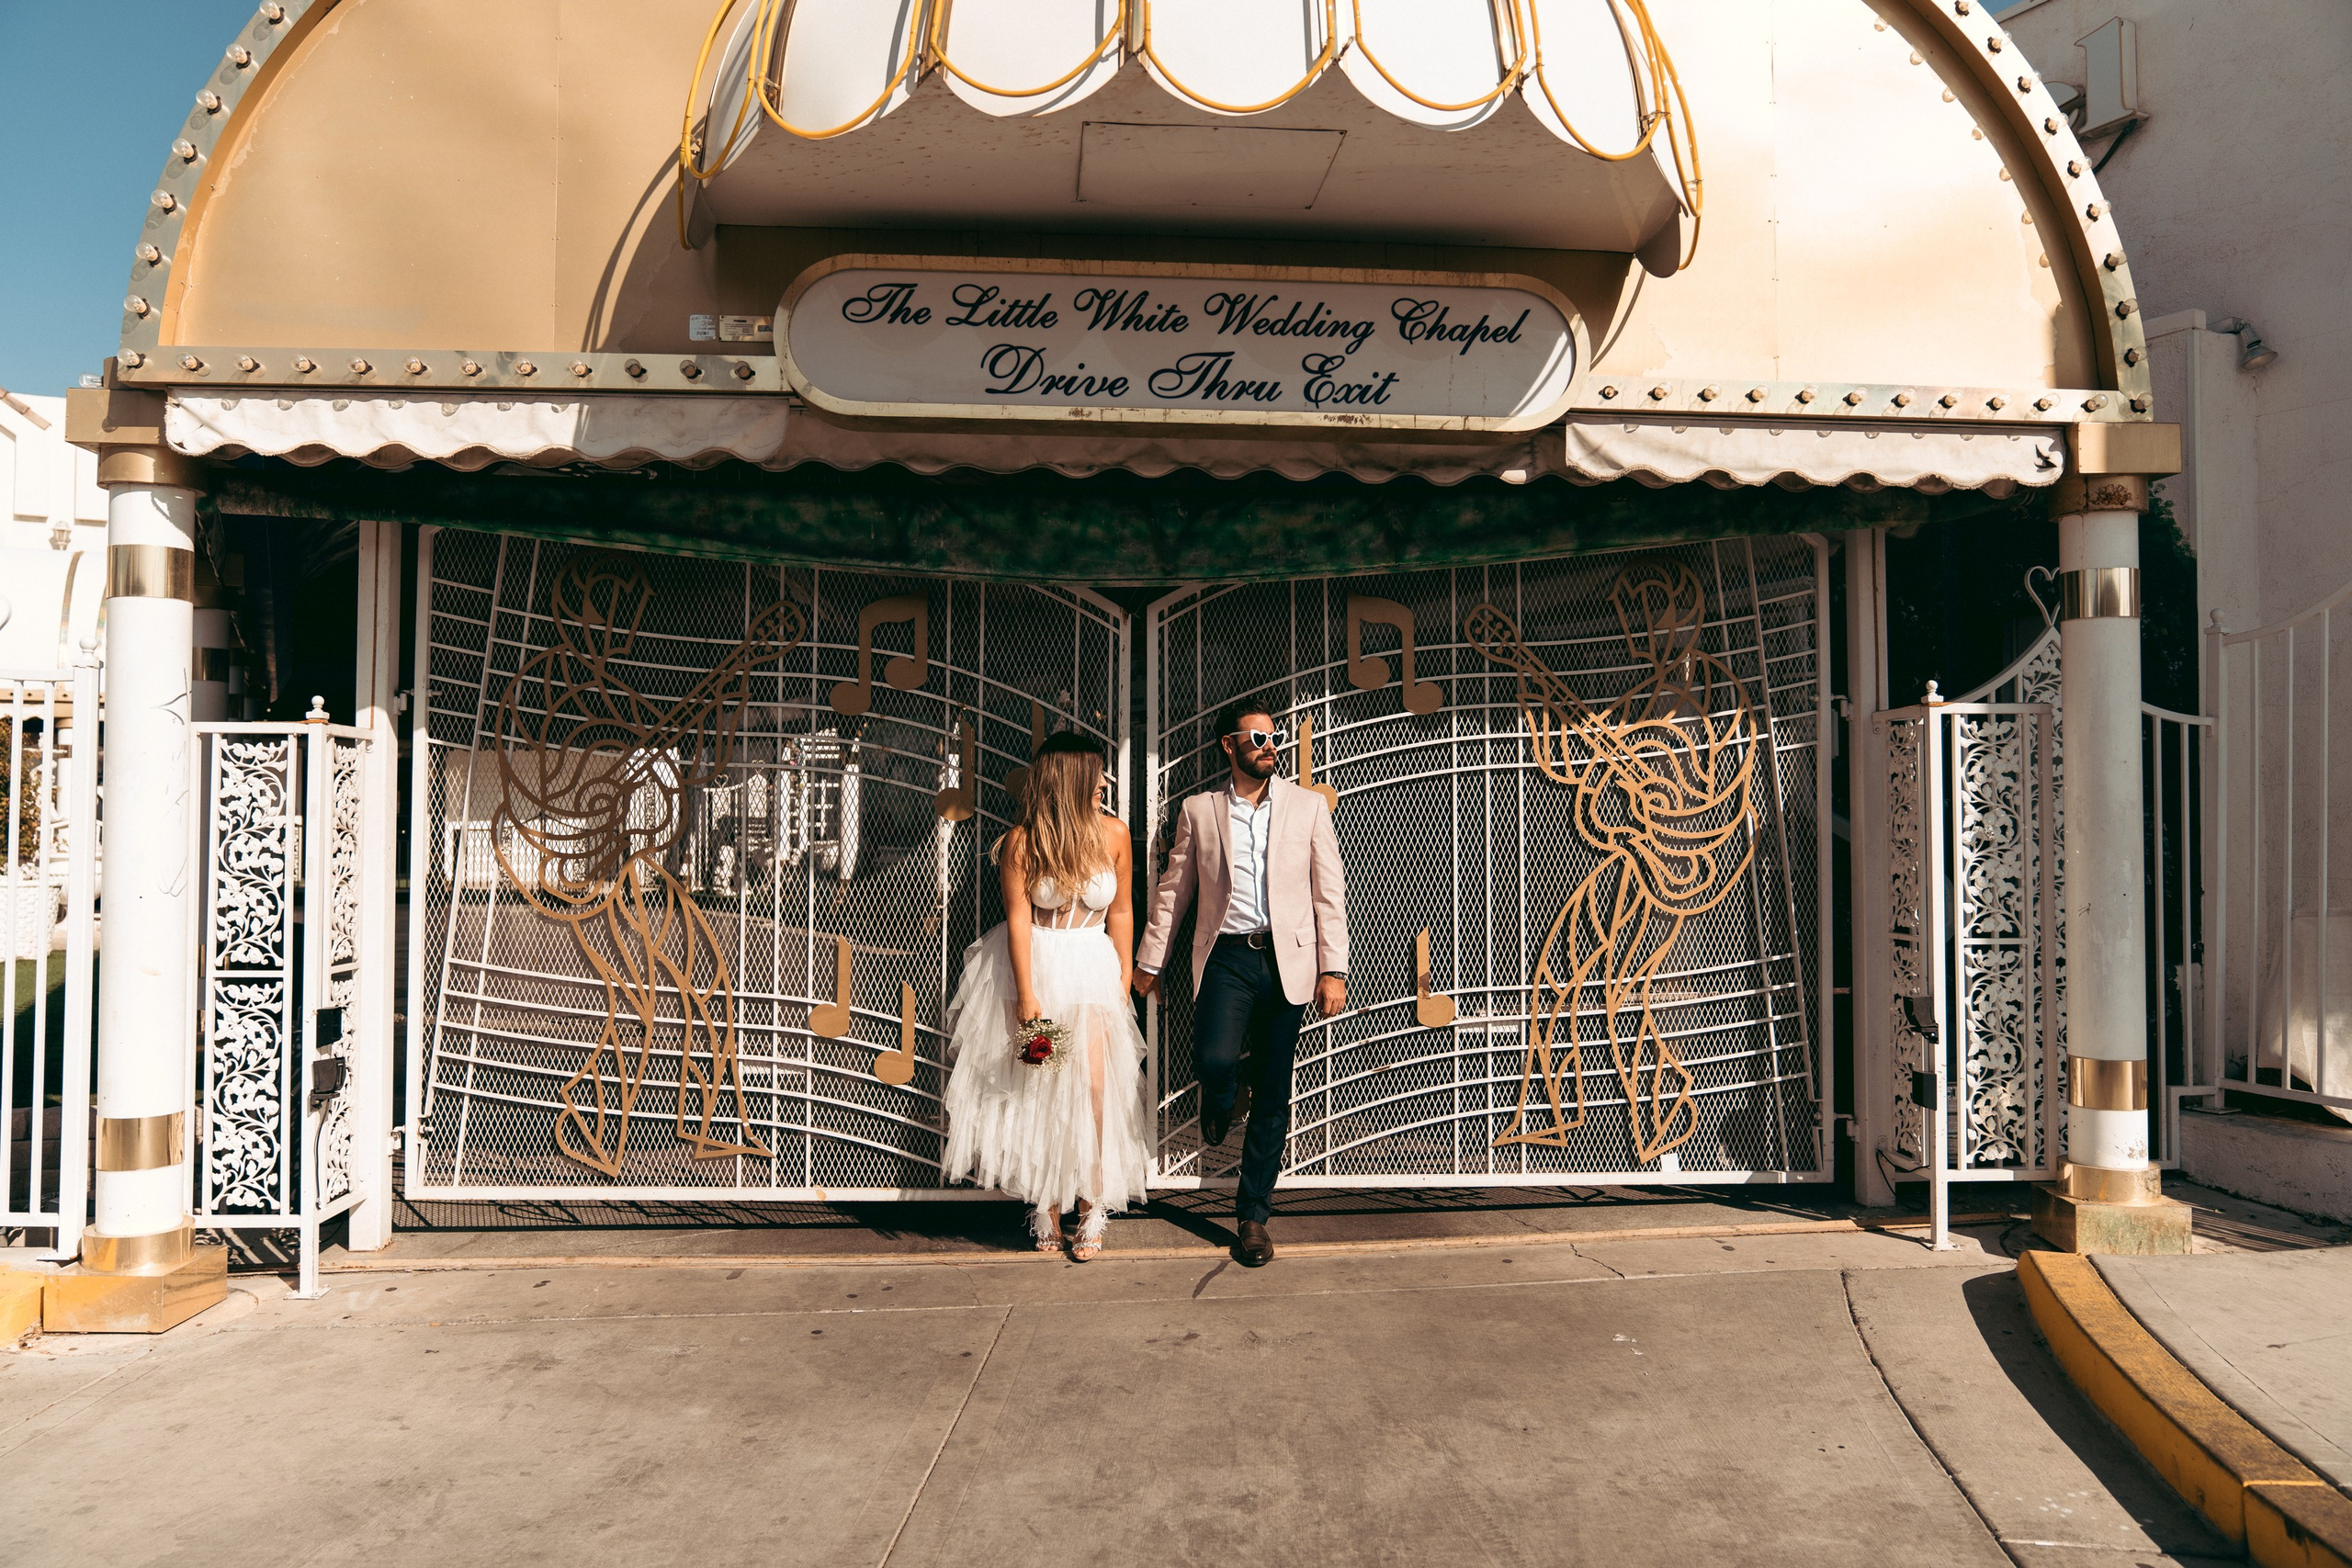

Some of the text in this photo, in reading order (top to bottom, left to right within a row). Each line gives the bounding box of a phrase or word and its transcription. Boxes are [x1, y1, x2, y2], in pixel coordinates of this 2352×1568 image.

[842, 282, 1532, 356] The Little White Wedding Chapel
[980, 343, 1400, 410] Drive Thru Exit
